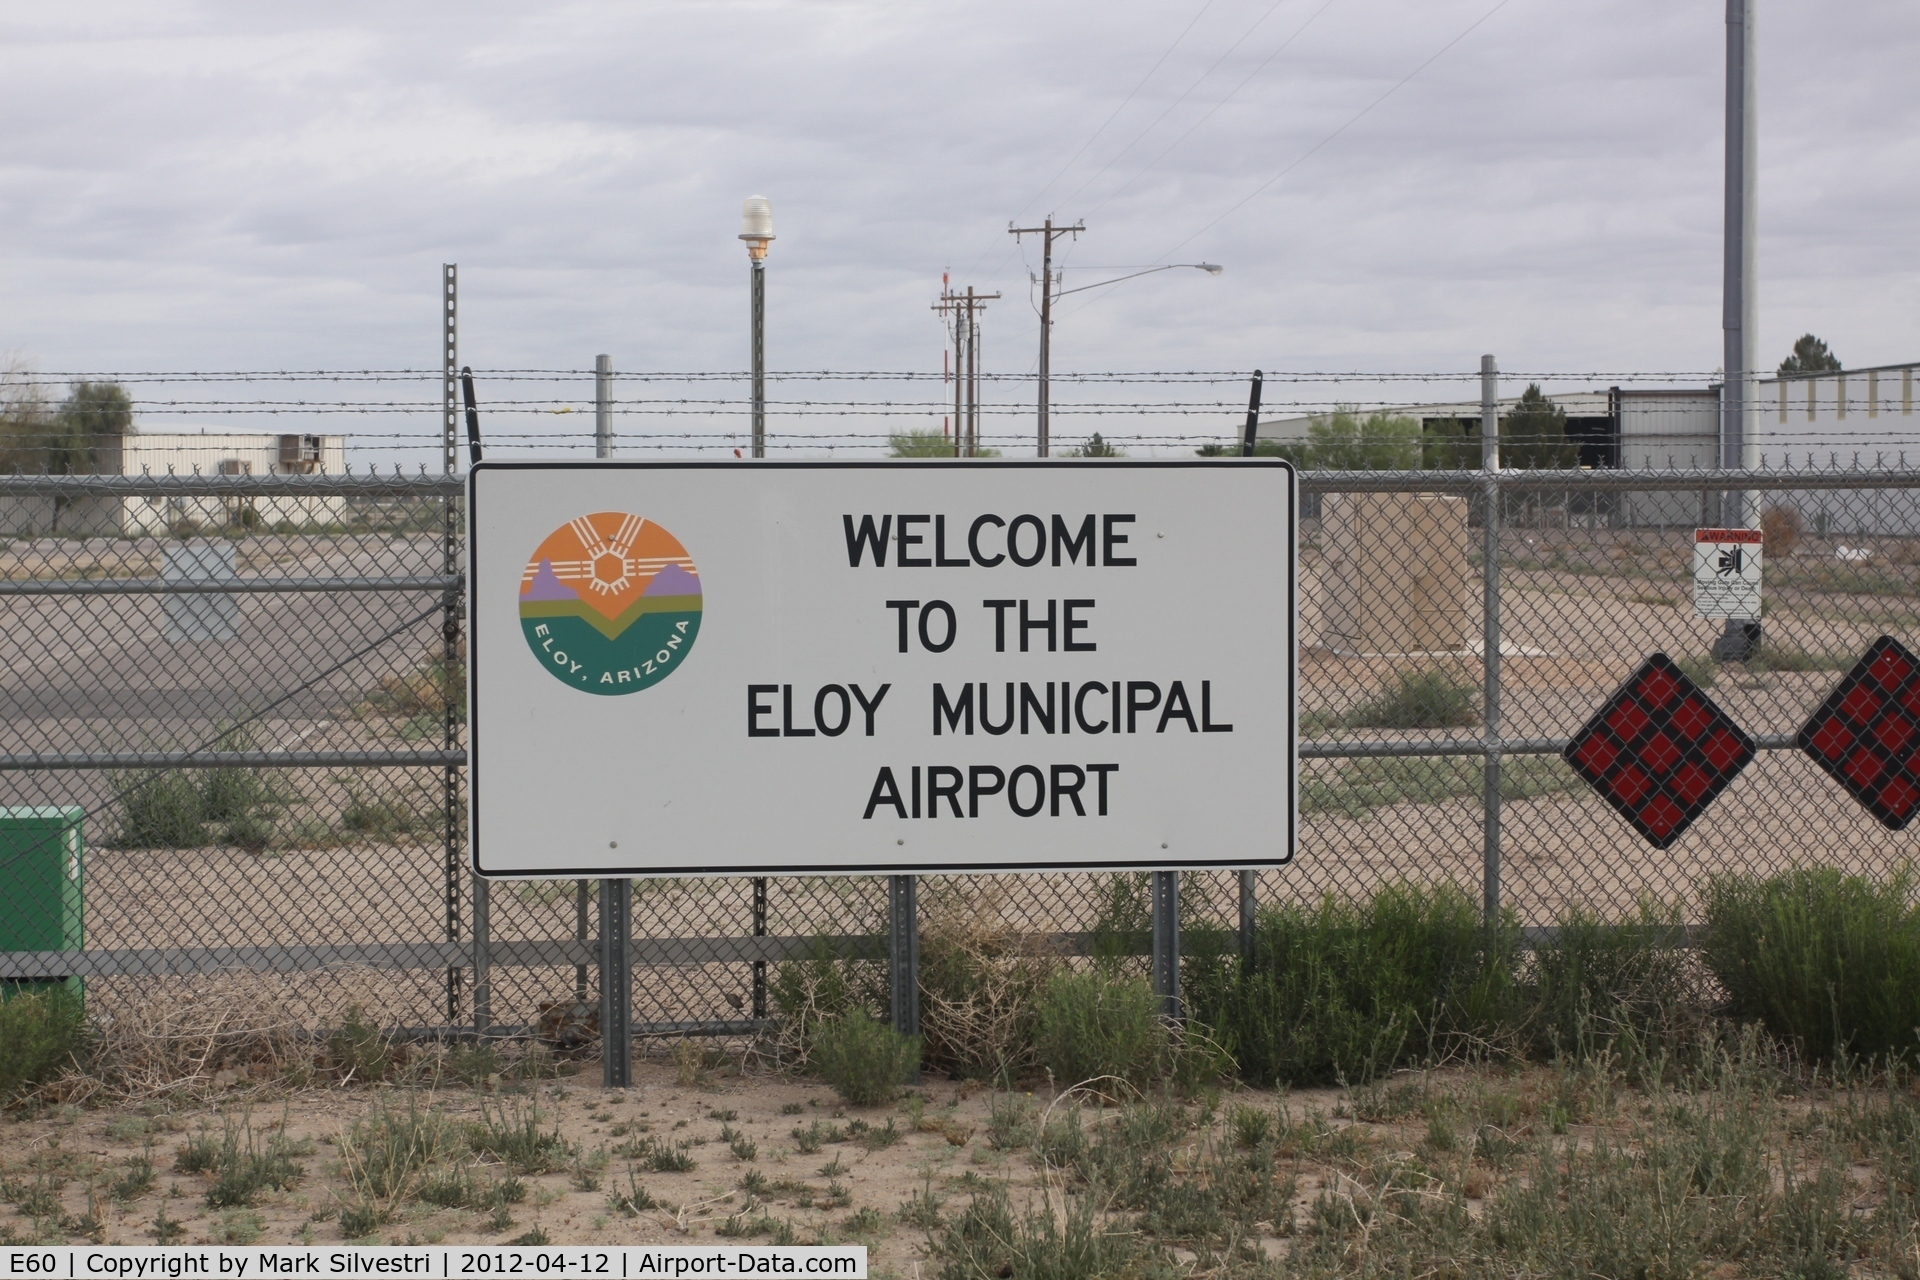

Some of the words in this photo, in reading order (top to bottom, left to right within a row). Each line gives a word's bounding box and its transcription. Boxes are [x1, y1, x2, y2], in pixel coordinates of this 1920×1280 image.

[842, 513, 1138, 568] WELCOME
[1709, 531, 1759, 542] WARNING
[534, 623, 587, 681] ELOY,
[600, 619, 690, 684] ARIZONA
[885, 599, 957, 654] TO
[982, 598, 1097, 653] THE
[747, 683, 892, 738] ELOY
[932, 679, 1234, 736] MUNICIPAL
[862, 763, 1120, 820] AIRPORT
